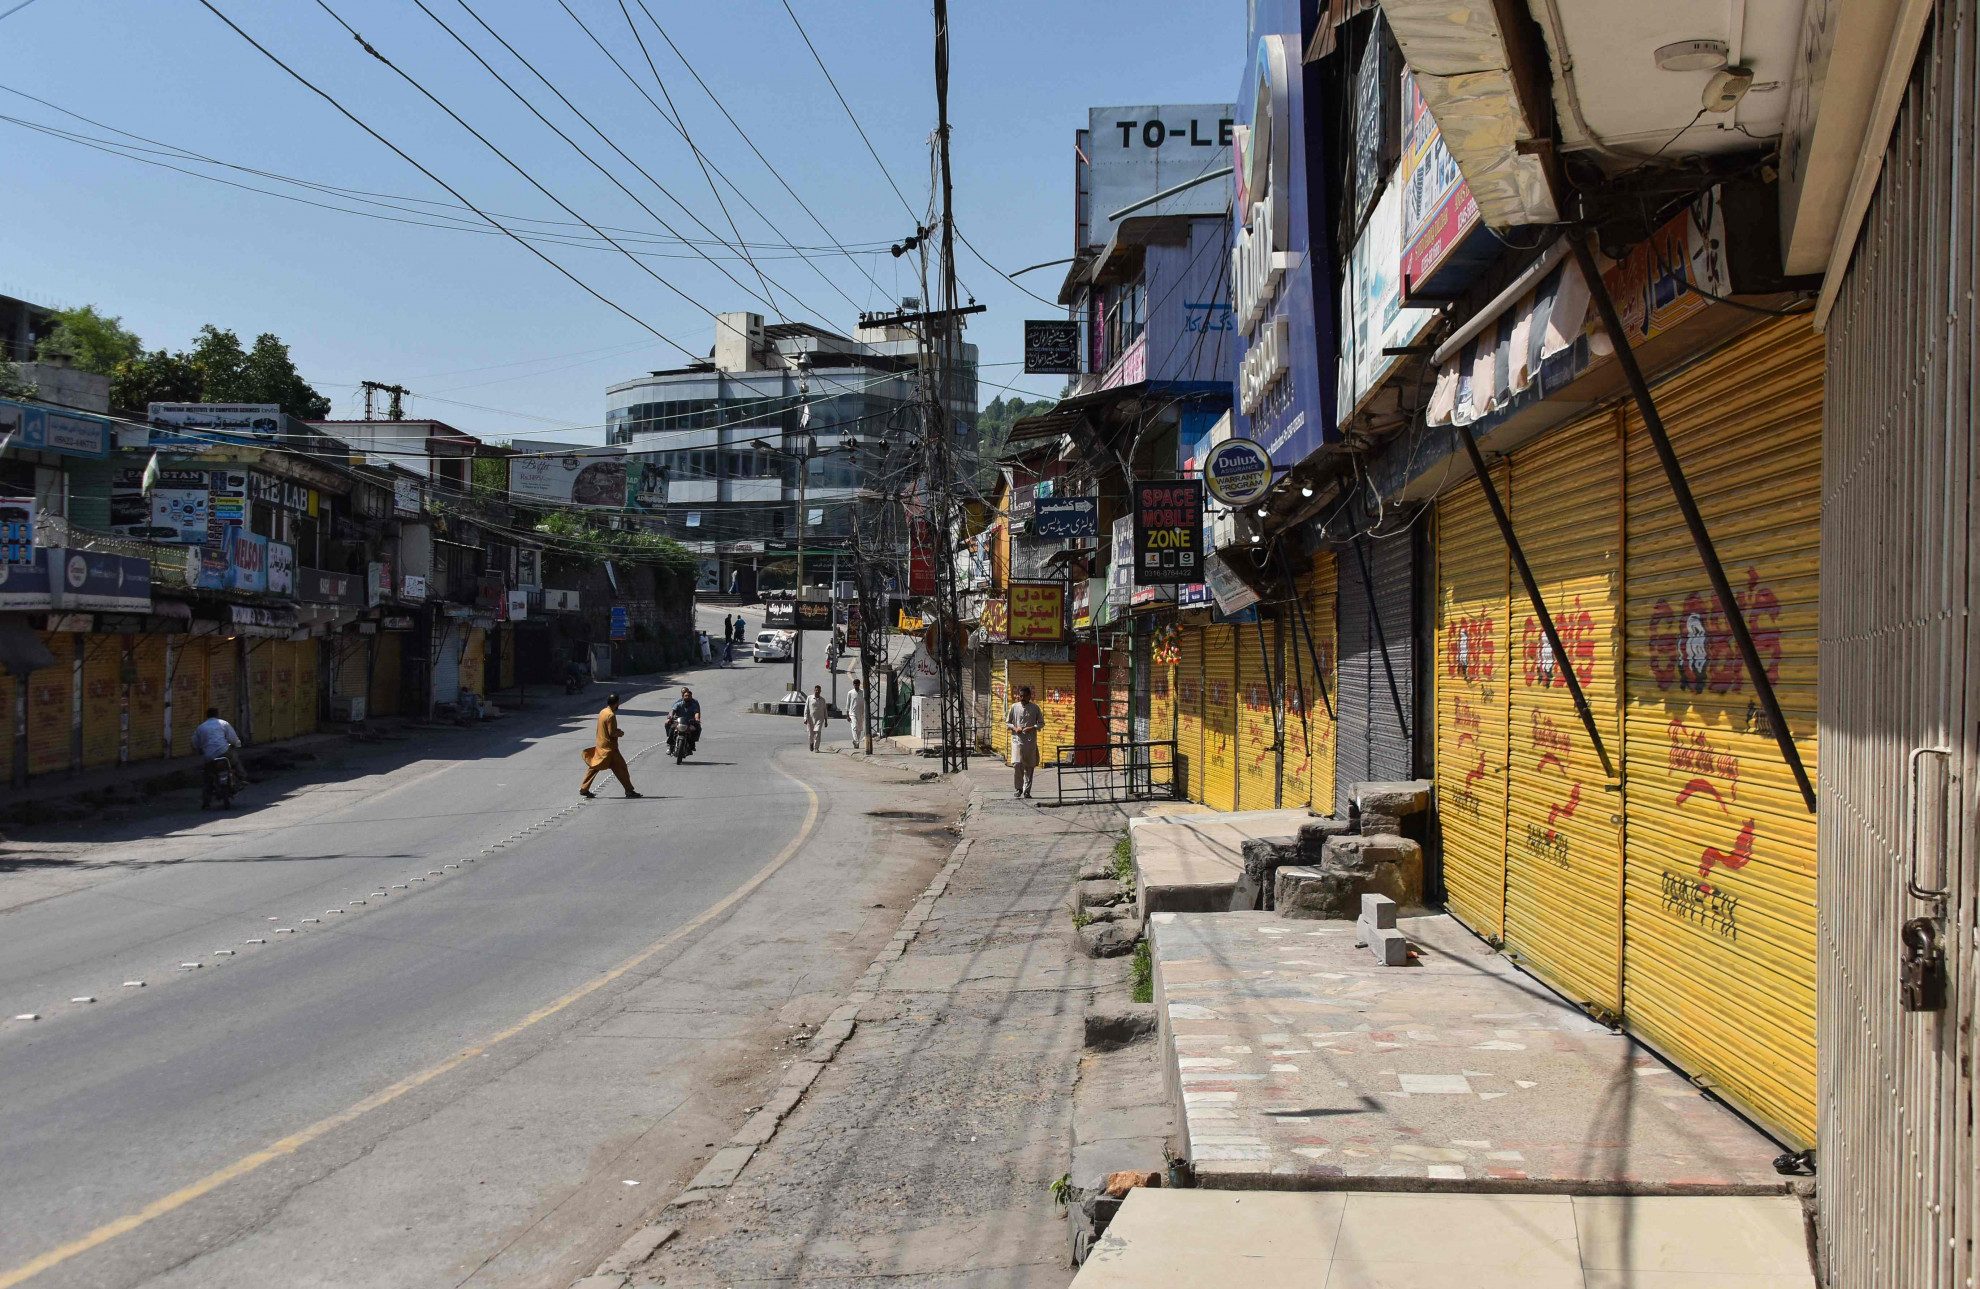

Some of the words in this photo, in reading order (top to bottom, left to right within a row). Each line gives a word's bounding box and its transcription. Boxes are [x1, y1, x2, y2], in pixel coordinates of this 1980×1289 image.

[1218, 455, 1258, 469] Dulux
[128, 470, 201, 480] PASTAN
[1221, 464, 1260, 475] ASSURANCE
[1216, 472, 1264, 485] WARRANTY
[1219, 480, 1265, 491] PROGRAM
[283, 482, 308, 511] LAB
[1142, 487, 1195, 507] SPACE
[1142, 508, 1196, 528] MOBILE
[1147, 530, 1191, 549] ZONE
